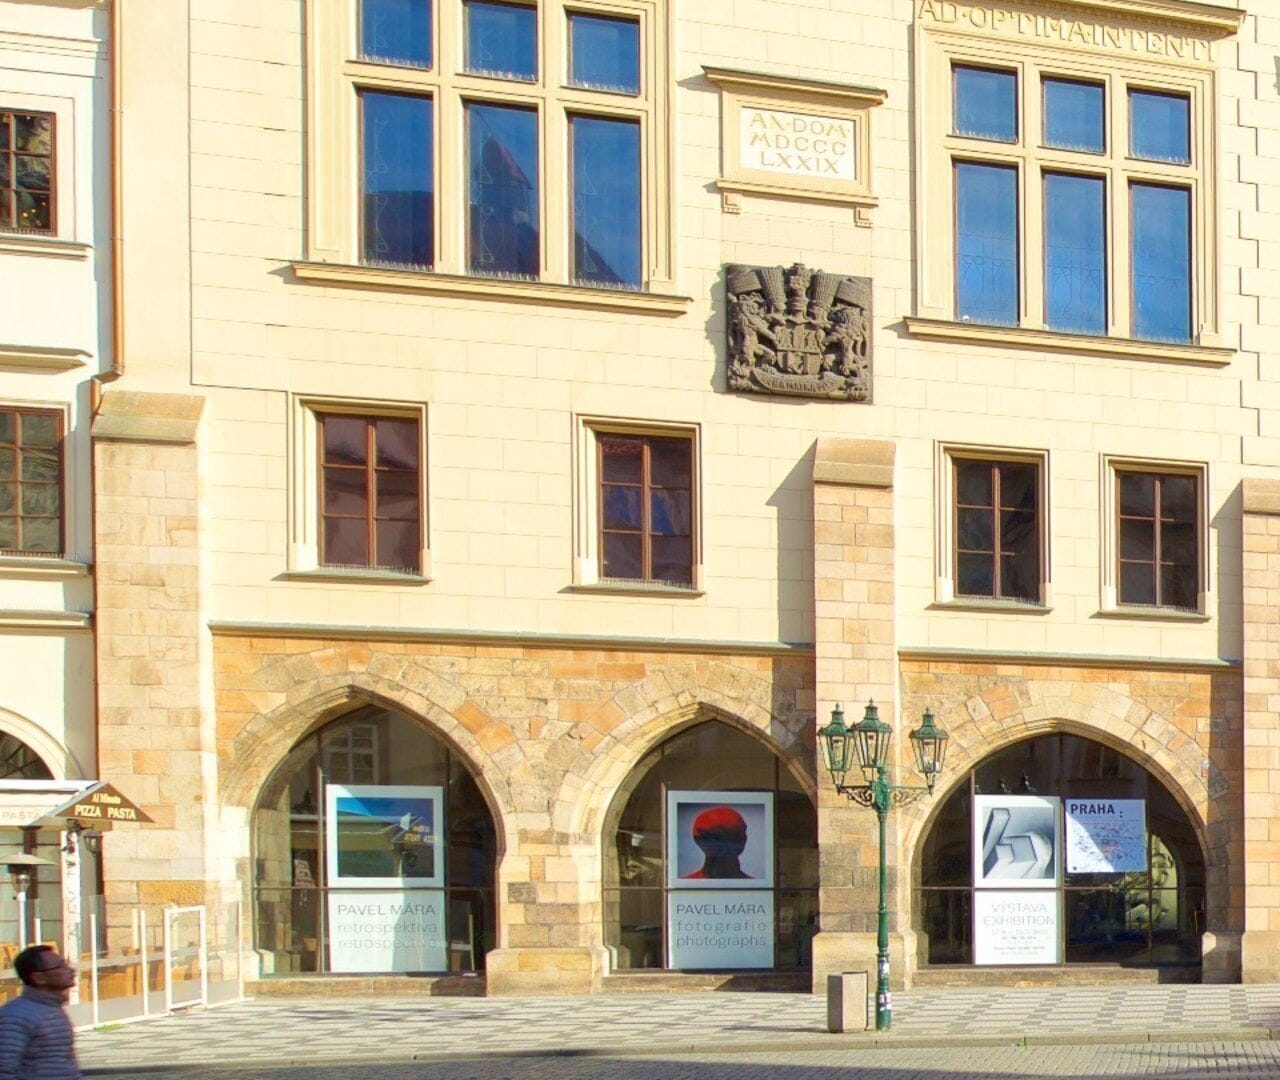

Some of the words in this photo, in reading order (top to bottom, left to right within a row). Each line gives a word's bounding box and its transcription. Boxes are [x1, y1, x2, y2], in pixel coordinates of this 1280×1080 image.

[74, 805, 102, 818] PIZZA
[107, 807, 136, 819] PASTA
[1070, 804, 1115, 815] PRAHA
[337, 904, 386, 916] PAVEL
[390, 902, 436, 916] MÁRA
[676, 904, 721, 916] PAVEL
[724, 902, 767, 915] MÁRA
[677, 920, 767, 934] fotografie
[983, 915, 1056, 926] EXHIBITION
[676, 935, 767, 949] photographs
